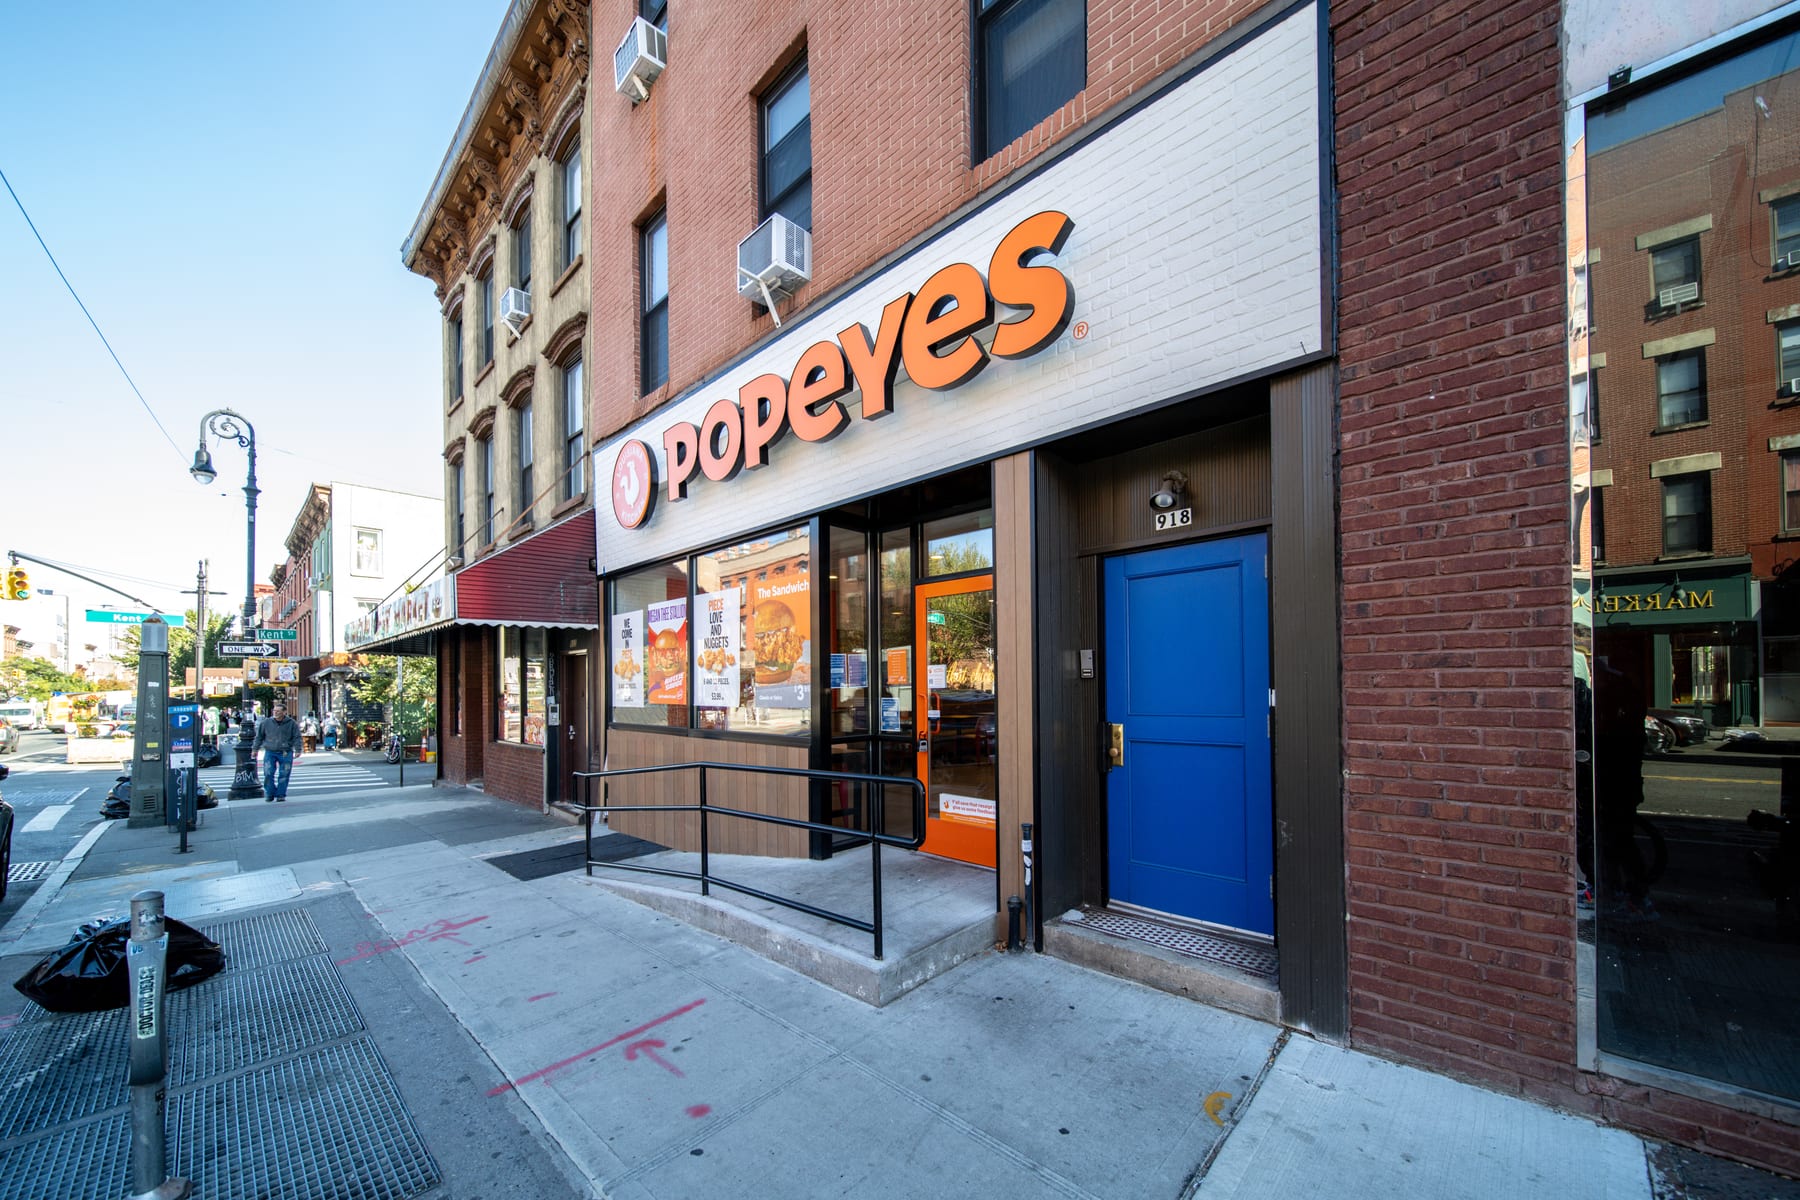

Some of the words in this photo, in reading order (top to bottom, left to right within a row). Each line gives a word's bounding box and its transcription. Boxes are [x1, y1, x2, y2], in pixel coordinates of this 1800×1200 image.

[1156, 510, 1190, 528] 918
[758, 587, 770, 598] The
[772, 580, 810, 597] Sandwich
[708, 598, 724, 612] PIECE
[113, 614, 142, 623] Kent
[624, 618, 630, 628] WE
[710, 611, 723, 624] LOVE
[260, 630, 284, 639] Kent
[622, 628, 632, 639] COME
[710, 624, 722, 636] AND
[704, 636, 728, 649] NUGGETS
[178, 715, 190, 727] P
